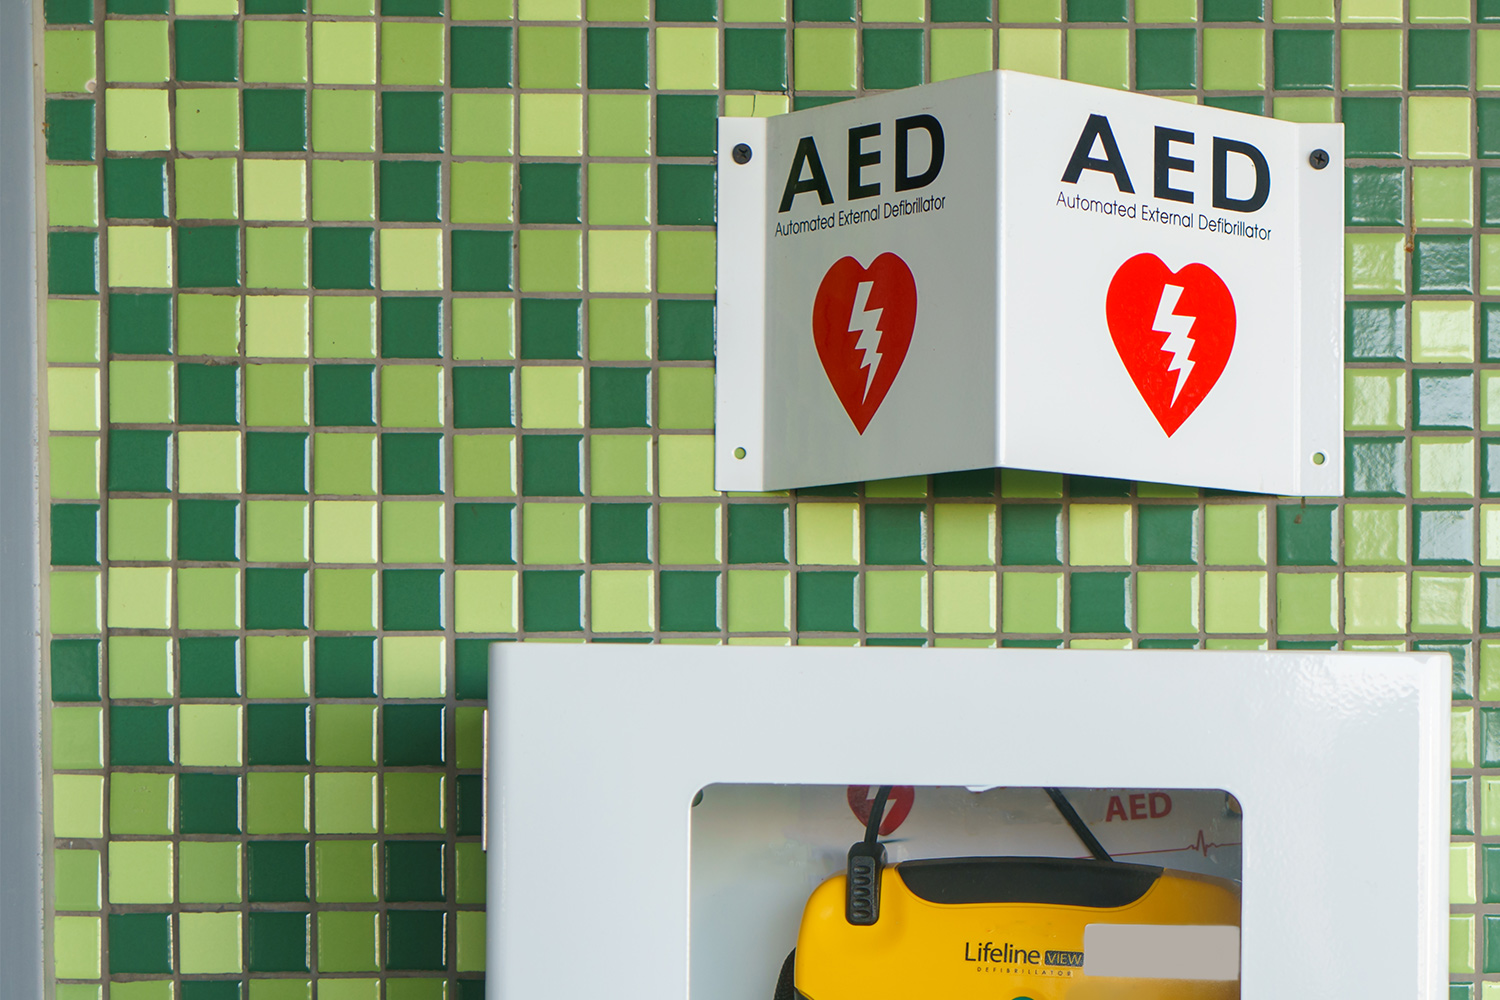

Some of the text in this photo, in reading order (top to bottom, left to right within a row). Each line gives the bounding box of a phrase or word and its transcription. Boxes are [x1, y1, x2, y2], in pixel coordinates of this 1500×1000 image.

[778, 114, 945, 213] AED
[1060, 113, 1271, 213] AED
[775, 195, 946, 237] Automated External Defibrillator
[1056, 191, 1271, 241] Automated External Defibrillator
[1105, 792, 1172, 822] AED
[965, 941, 1083, 966] Lifeline VIEW
[976, 966, 1072, 977] DEFIBRILLATOR
